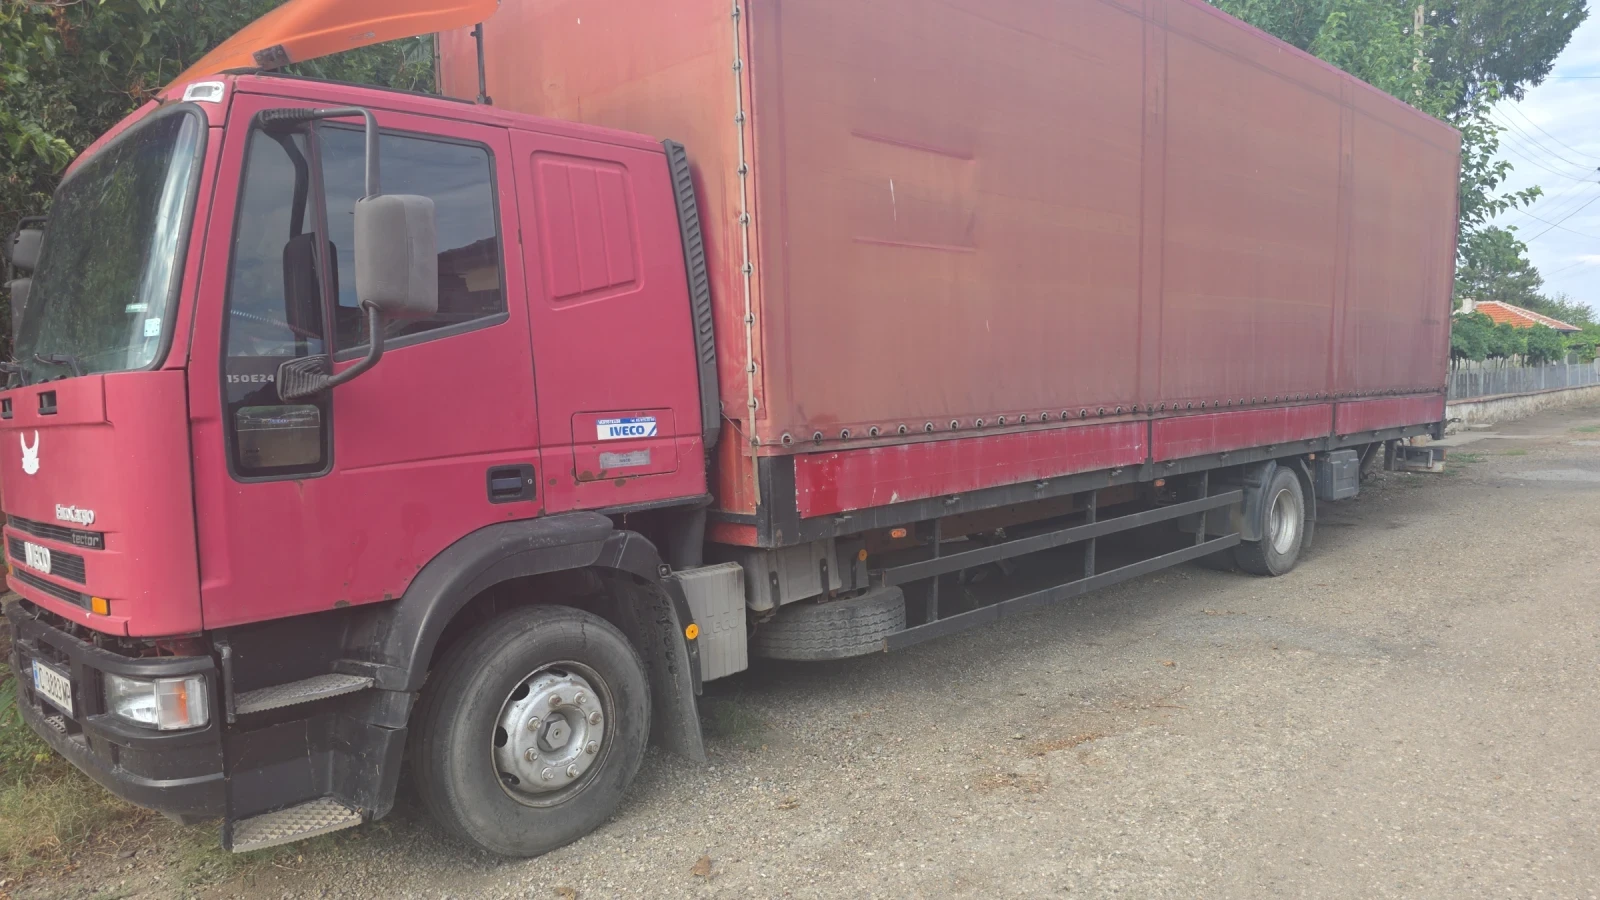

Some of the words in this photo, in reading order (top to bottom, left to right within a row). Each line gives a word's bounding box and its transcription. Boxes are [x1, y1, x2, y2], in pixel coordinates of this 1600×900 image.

[227, 374, 275, 383] 150E24
[609, 425, 645, 437] IVECO
[56, 503, 95, 526] EuroCargo
[71, 533, 99, 547] tector
